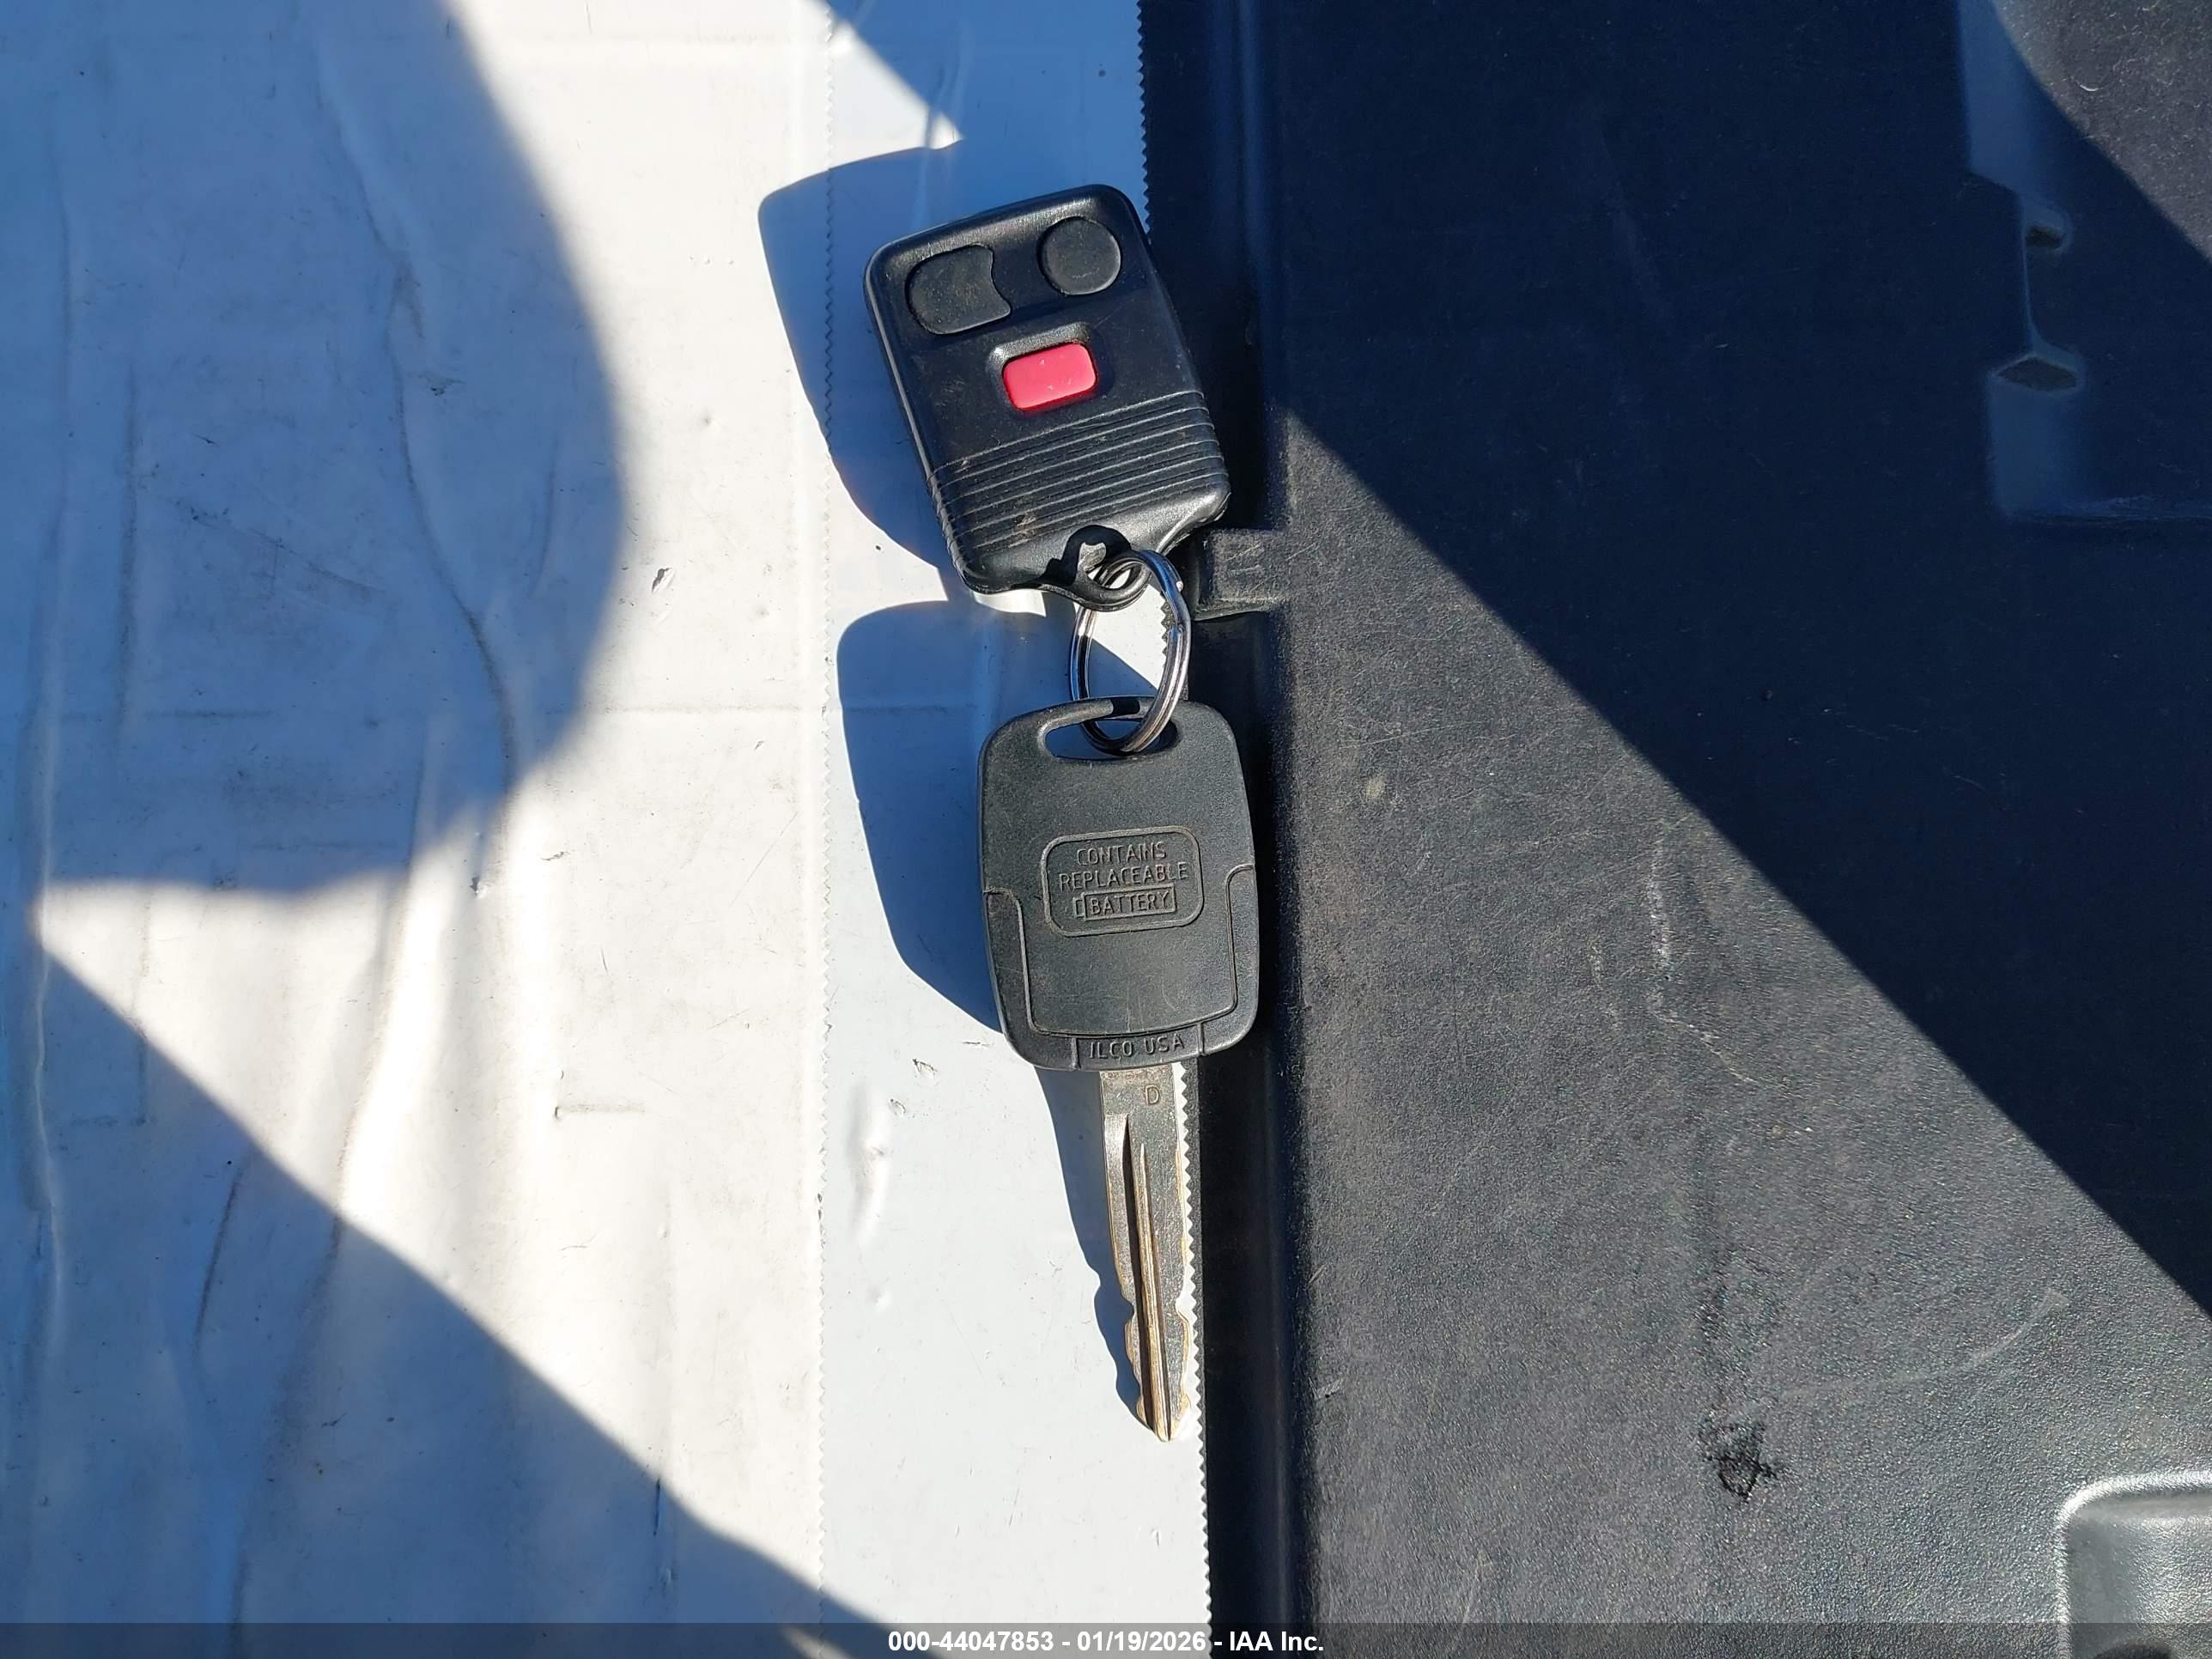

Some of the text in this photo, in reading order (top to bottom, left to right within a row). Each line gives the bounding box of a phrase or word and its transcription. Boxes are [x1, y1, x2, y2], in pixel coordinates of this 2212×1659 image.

[1076, 841, 1168, 866] CONTAINS
[1059, 861, 1189, 891] REPLACEABLE
[1089, 890, 1170, 916] BATTERY
[1089, 1032, 1185, 1060] ILCO USA
[1145, 1085, 1159, 1105] D
